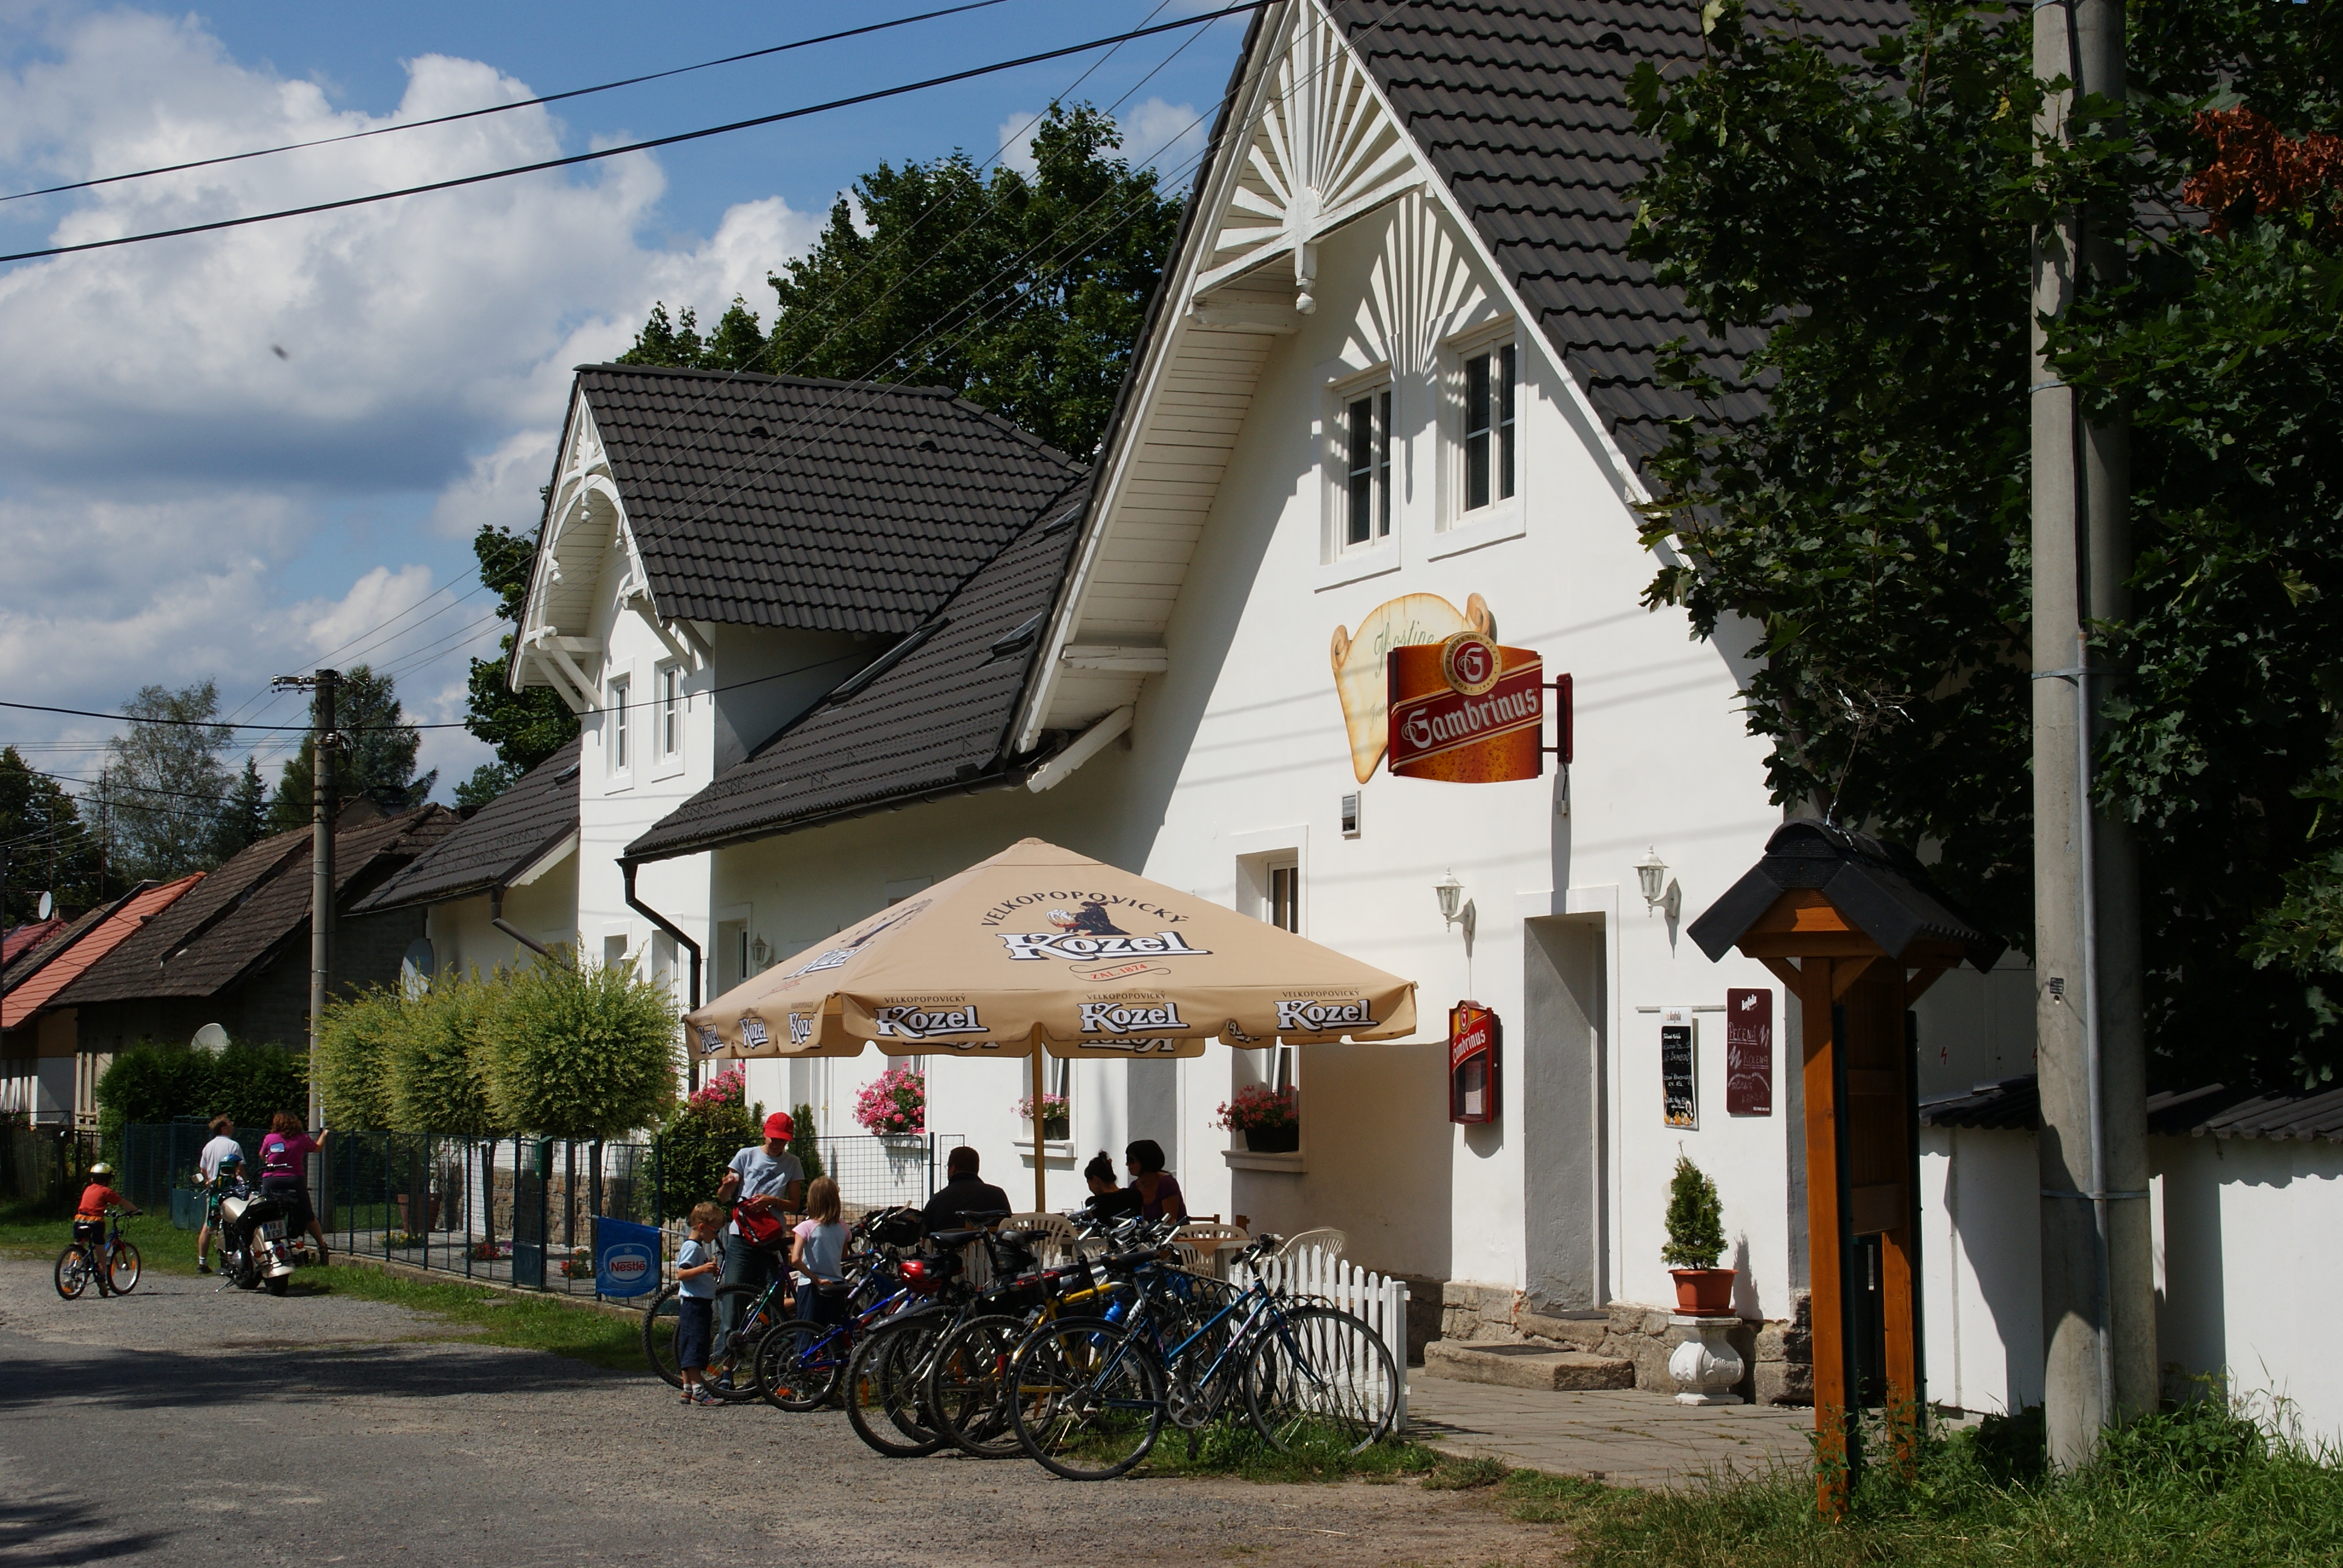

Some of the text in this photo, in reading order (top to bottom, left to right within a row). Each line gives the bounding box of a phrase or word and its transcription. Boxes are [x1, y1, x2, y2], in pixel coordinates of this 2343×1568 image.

[1374, 619, 1443, 678] Hostine
[1401, 688, 1539, 749] Gambrinus
[981, 890, 1189, 926] VELKOPOPOVICKÝ
[995, 931, 1214, 961] Kozel
[884, 993, 966, 1004] VELKOPOPOVICKÝ
[1087, 991, 1165, 1000] VELKOPOPOVICKÝ
[1282, 988, 1360, 998] VELKOPOPOVICKÝ
[788, 1011, 817, 1045] Koze
[874, 1005, 991, 1039] Kozel
[1077, 1002, 1190, 1034] Kozel
[1274, 999, 1380, 1032] Kozel
[696, 1024, 725, 1054] Kozel
[738, 1018, 769, 1049] Kozel
[1452, 1030, 1486, 1064] Gambrinus
[611, 1261, 646, 1271] Nestlé
